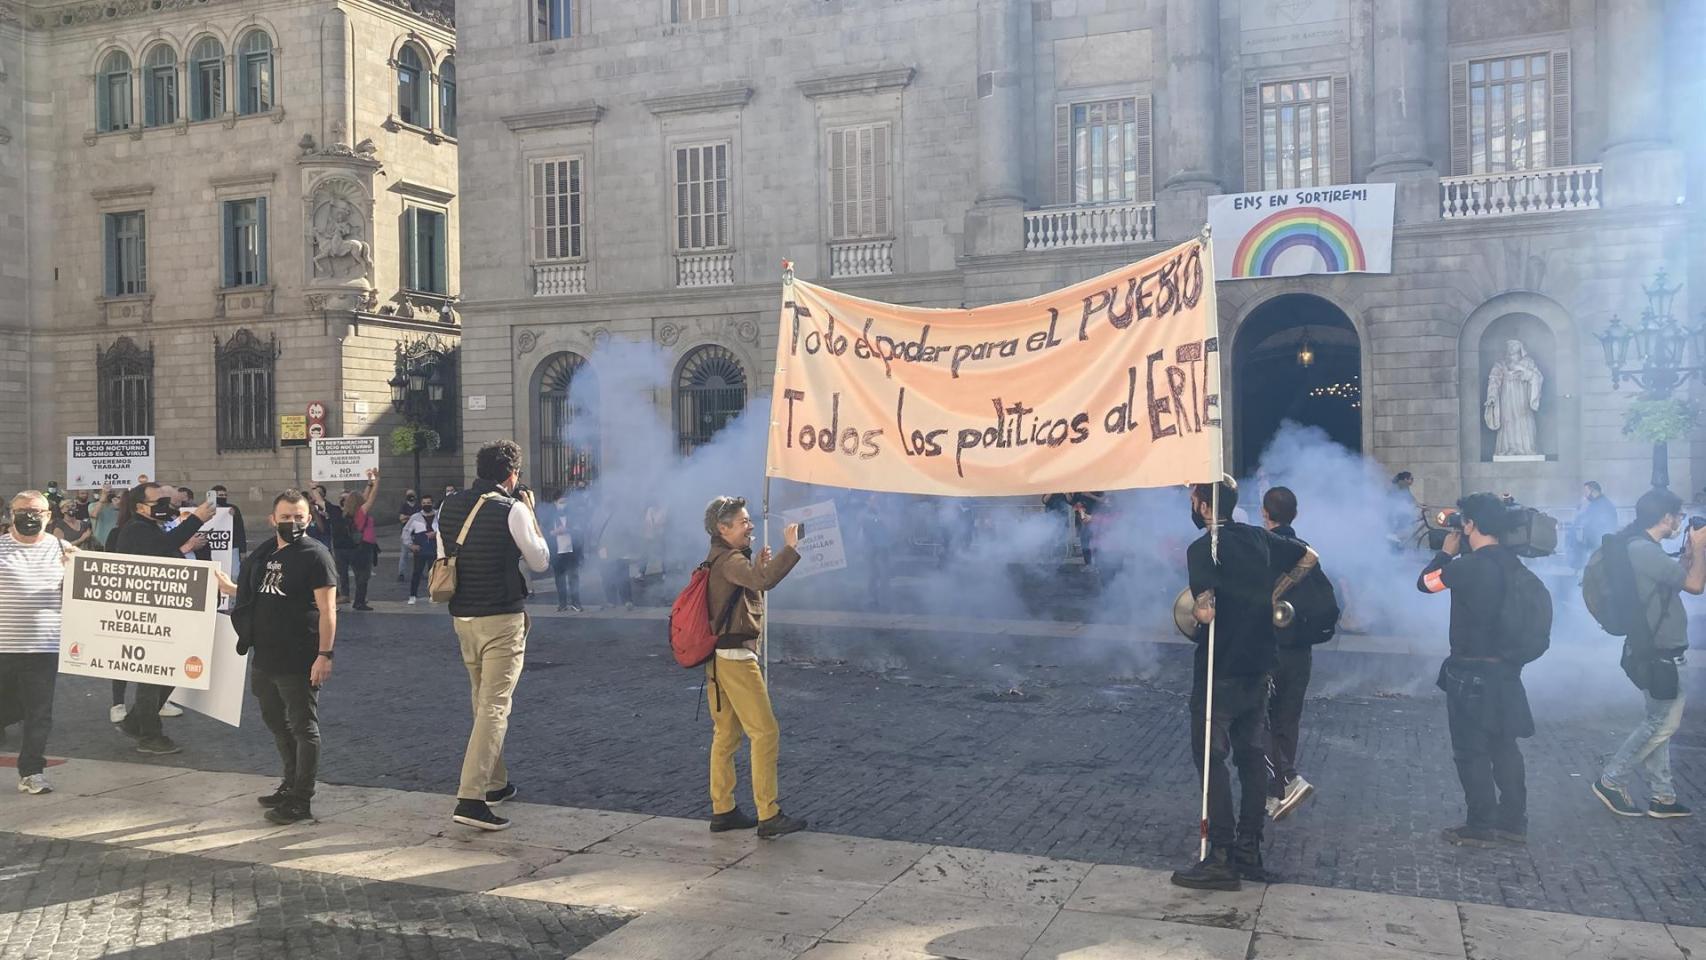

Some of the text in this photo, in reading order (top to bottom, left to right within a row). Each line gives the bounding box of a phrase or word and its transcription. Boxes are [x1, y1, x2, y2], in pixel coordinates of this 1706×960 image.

[1234, 190, 1367, 210] ENS EN SORTIREM!
[784, 301, 848, 356] Todo
[876, 324, 952, 378] poder
[951, 338, 1019, 378] para
[1026, 307, 1062, 352] el
[784, 388, 884, 460] Todos
[1104, 366, 1138, 434] al
[1146, 336, 1222, 444] ERTE
[209, 541, 227, 549] RUS
[83, 561, 198, 581] LA RESTAURACIÓ I
[91, 575, 187, 594] L'OCI NOCTURN
[84, 588, 193, 608] NO SOM EL VIRUS
[115, 609, 157, 624] VOLEM
[100, 620, 171, 637] TREBALLAR
[121, 644, 146, 660] NO
[90, 658, 104, 668] AL
[108, 660, 176, 676] TANCAMENT
